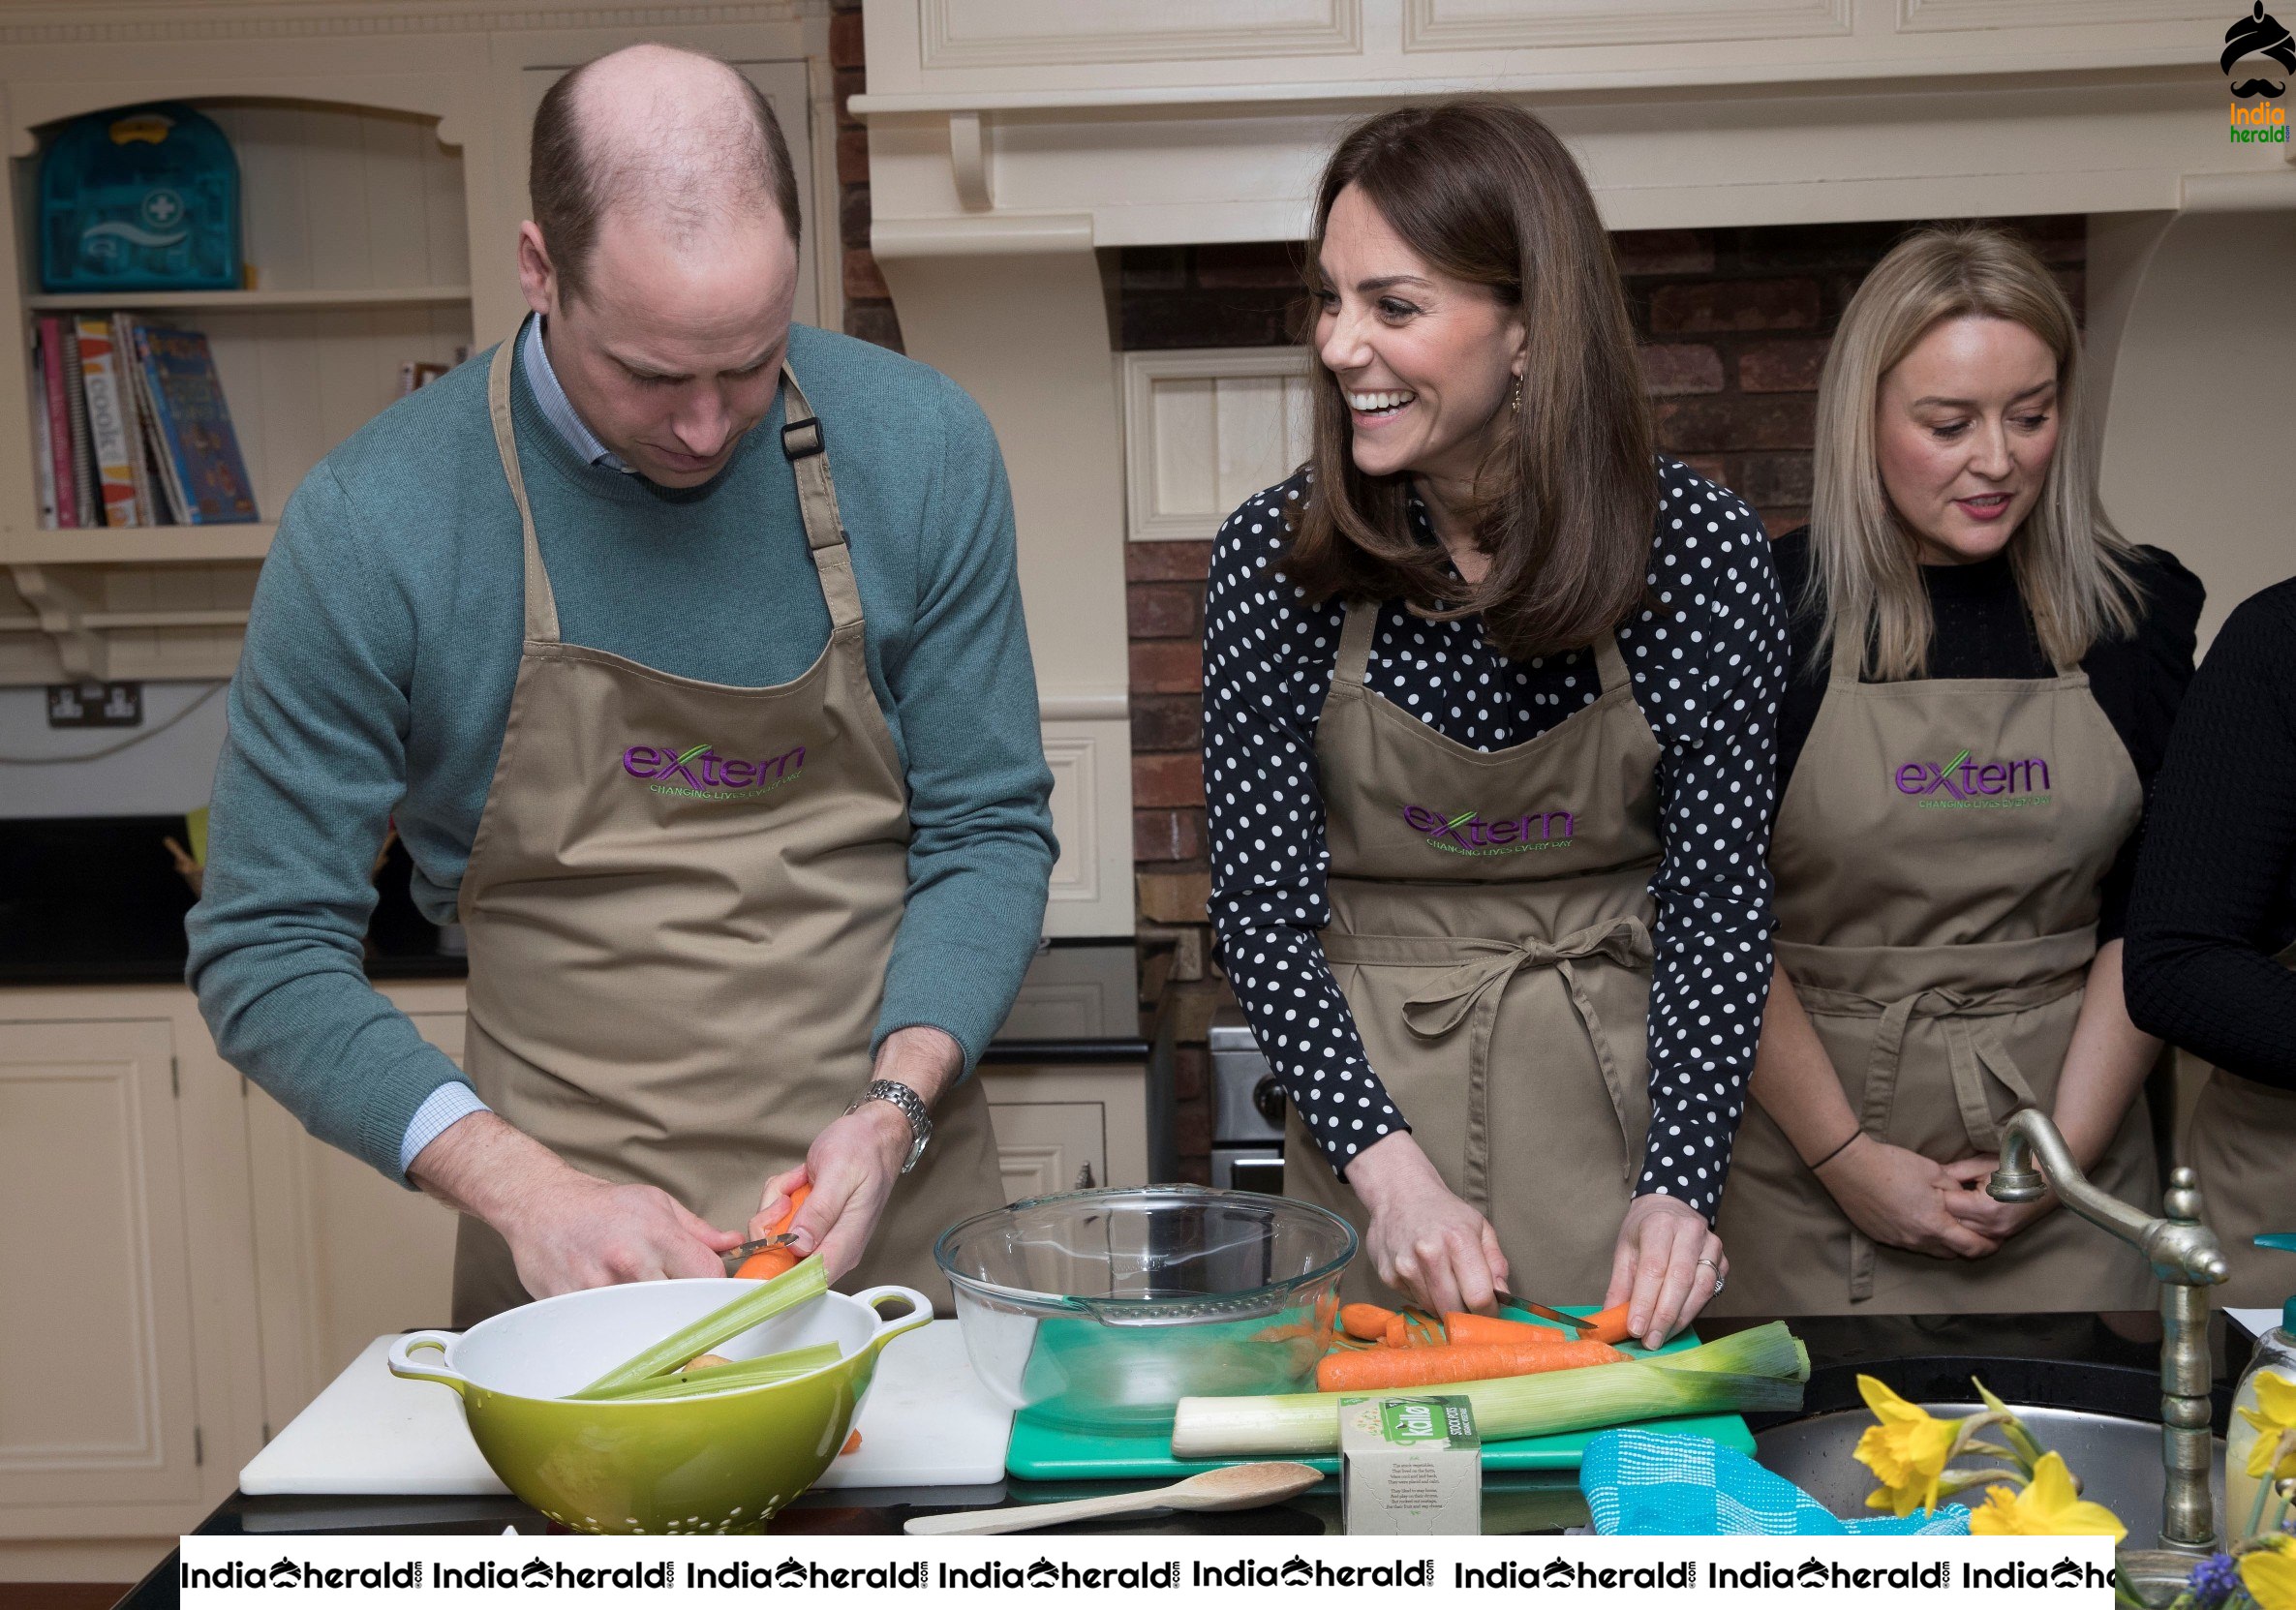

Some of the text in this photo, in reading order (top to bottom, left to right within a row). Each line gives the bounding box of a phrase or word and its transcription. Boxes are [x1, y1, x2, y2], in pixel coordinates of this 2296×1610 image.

[623, 744, 807, 792] extern
[1895, 749, 2051, 800] extern
[650, 784, 711, 800] CHANGING
[1918, 800, 1972, 809] CHANGING
[1404, 805, 1574, 850] extern
[1426, 838, 1481, 856] CHANGING
[1551, 839, 1573, 848] DAY
[1446, 1407, 1462, 1436] STOCK POTS
